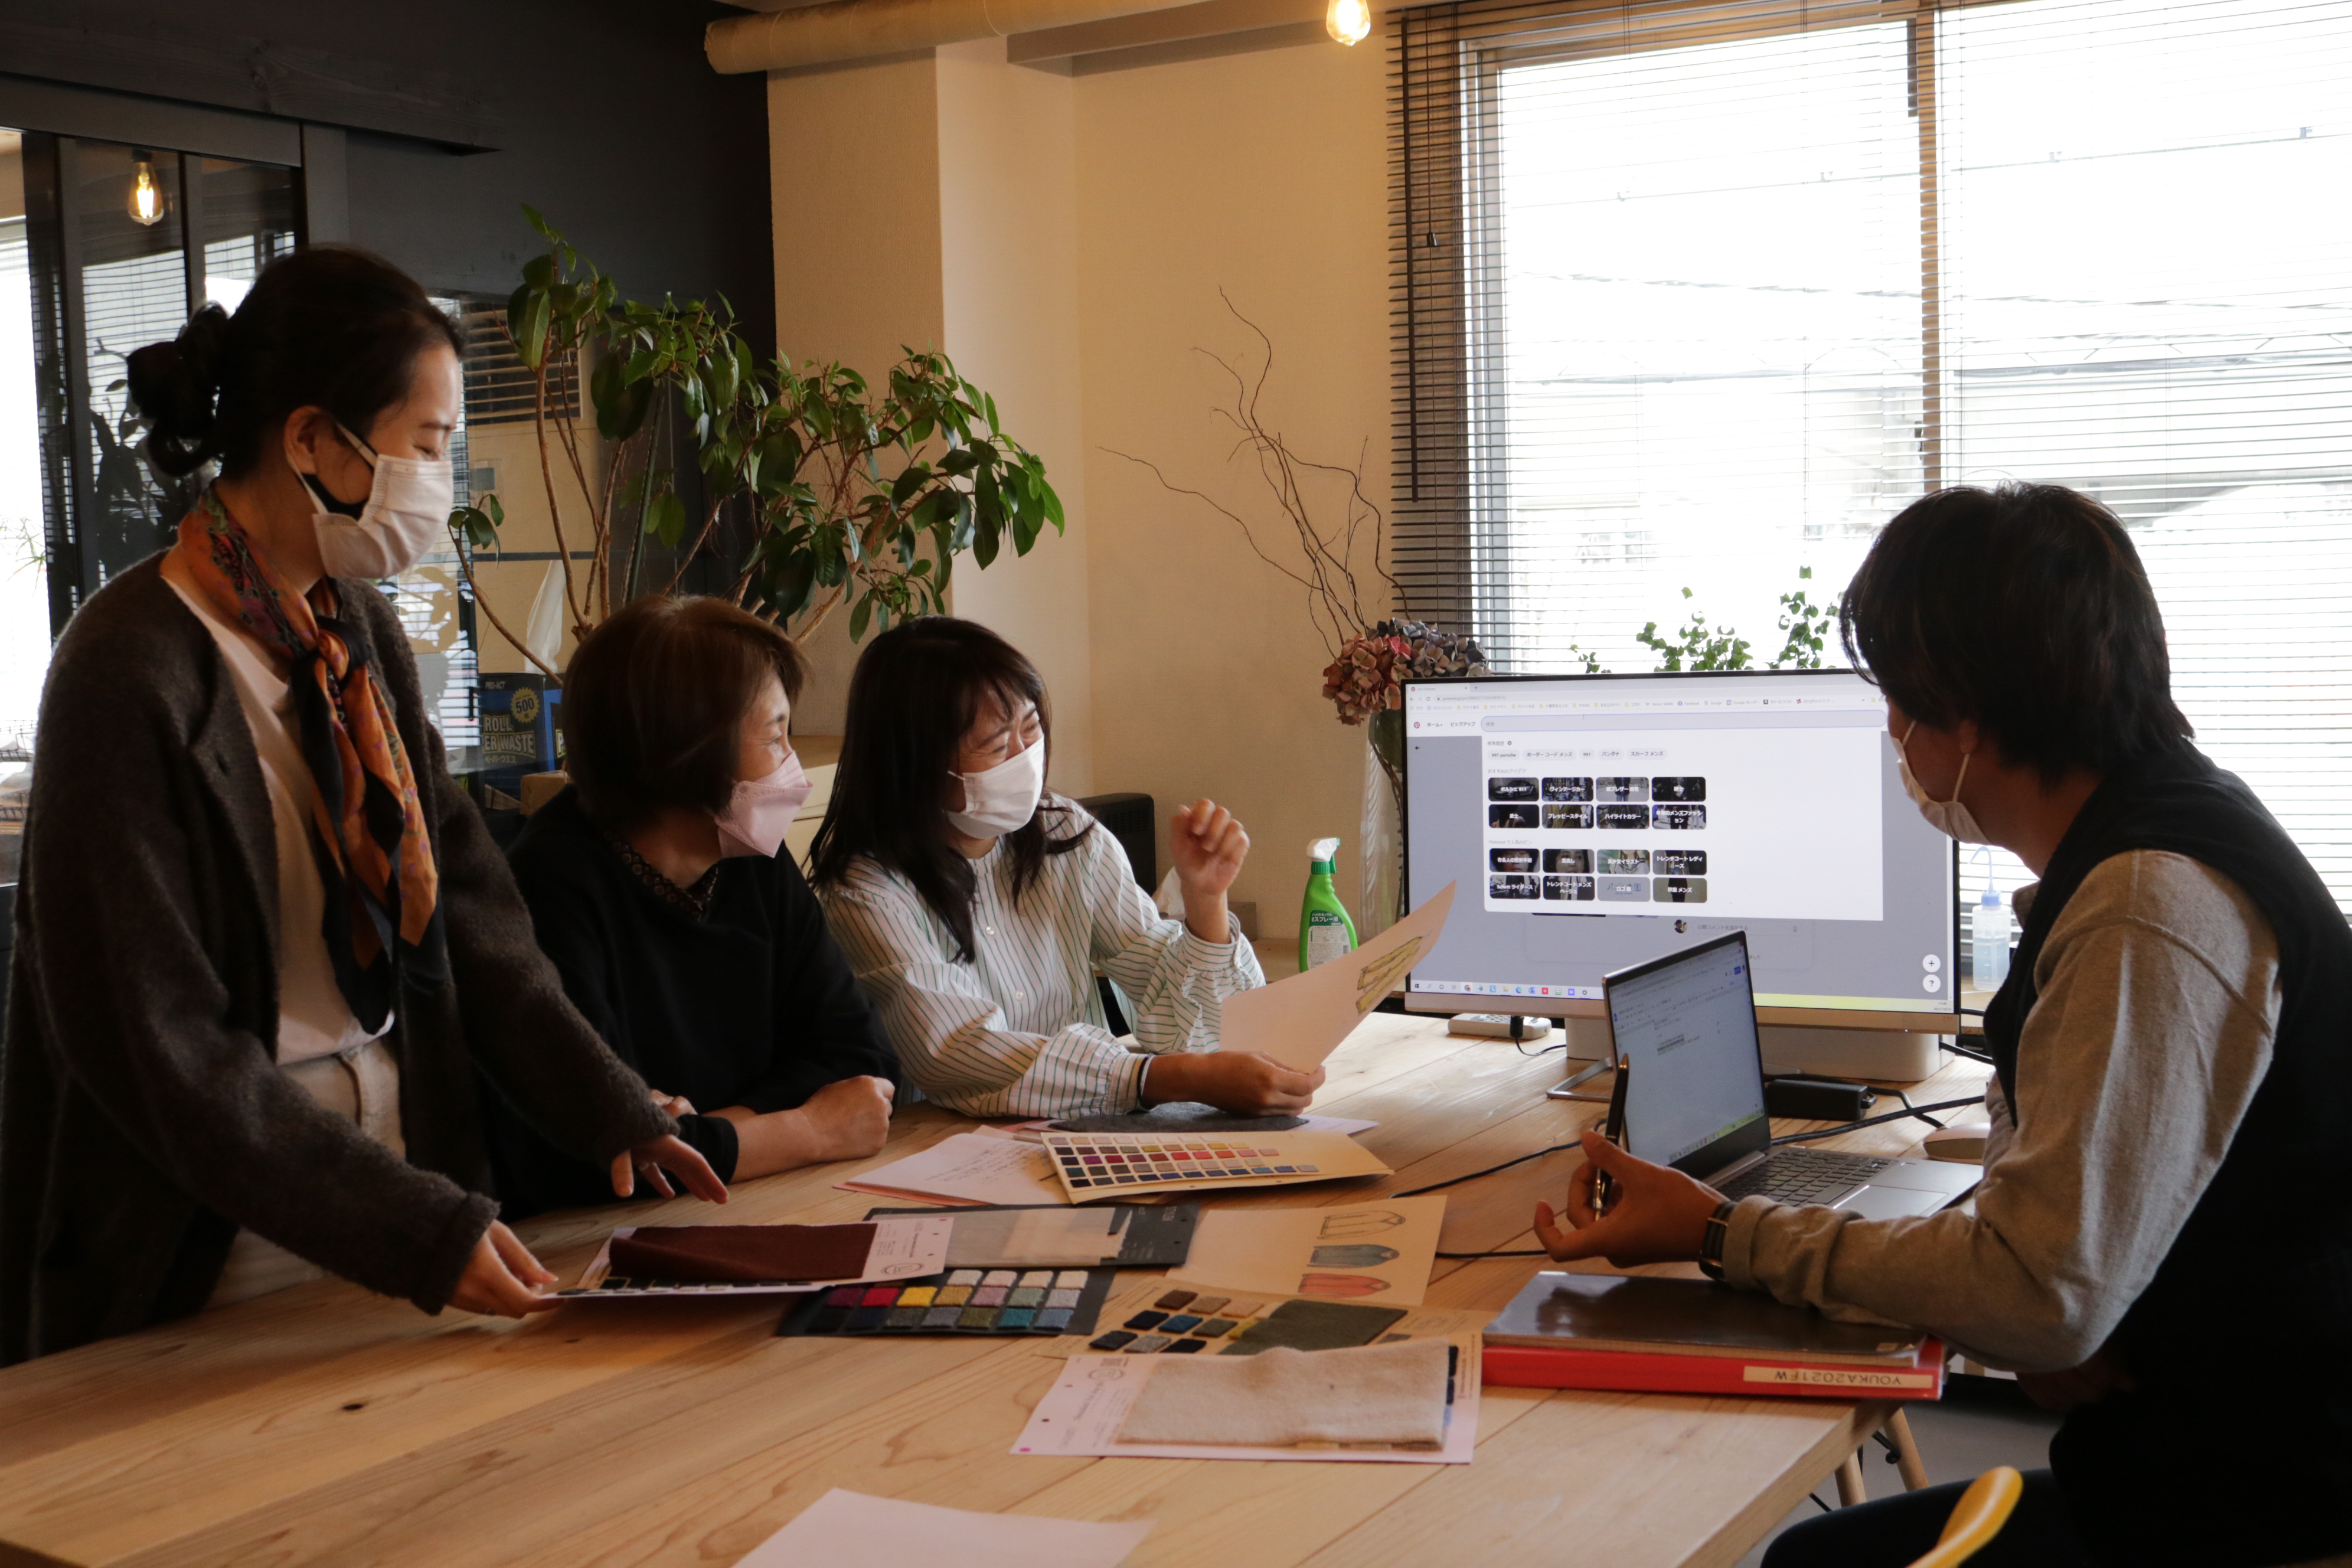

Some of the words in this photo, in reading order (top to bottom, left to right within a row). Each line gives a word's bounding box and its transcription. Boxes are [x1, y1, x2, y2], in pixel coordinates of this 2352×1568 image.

[485, 681, 505, 690] PRO-ACT
[515, 698, 534, 714] 500
[485, 717, 512, 732] ROLL
[501, 733, 534, 753] WASTE
[1775, 1370, 1901, 1386] YOUKA2021FW
